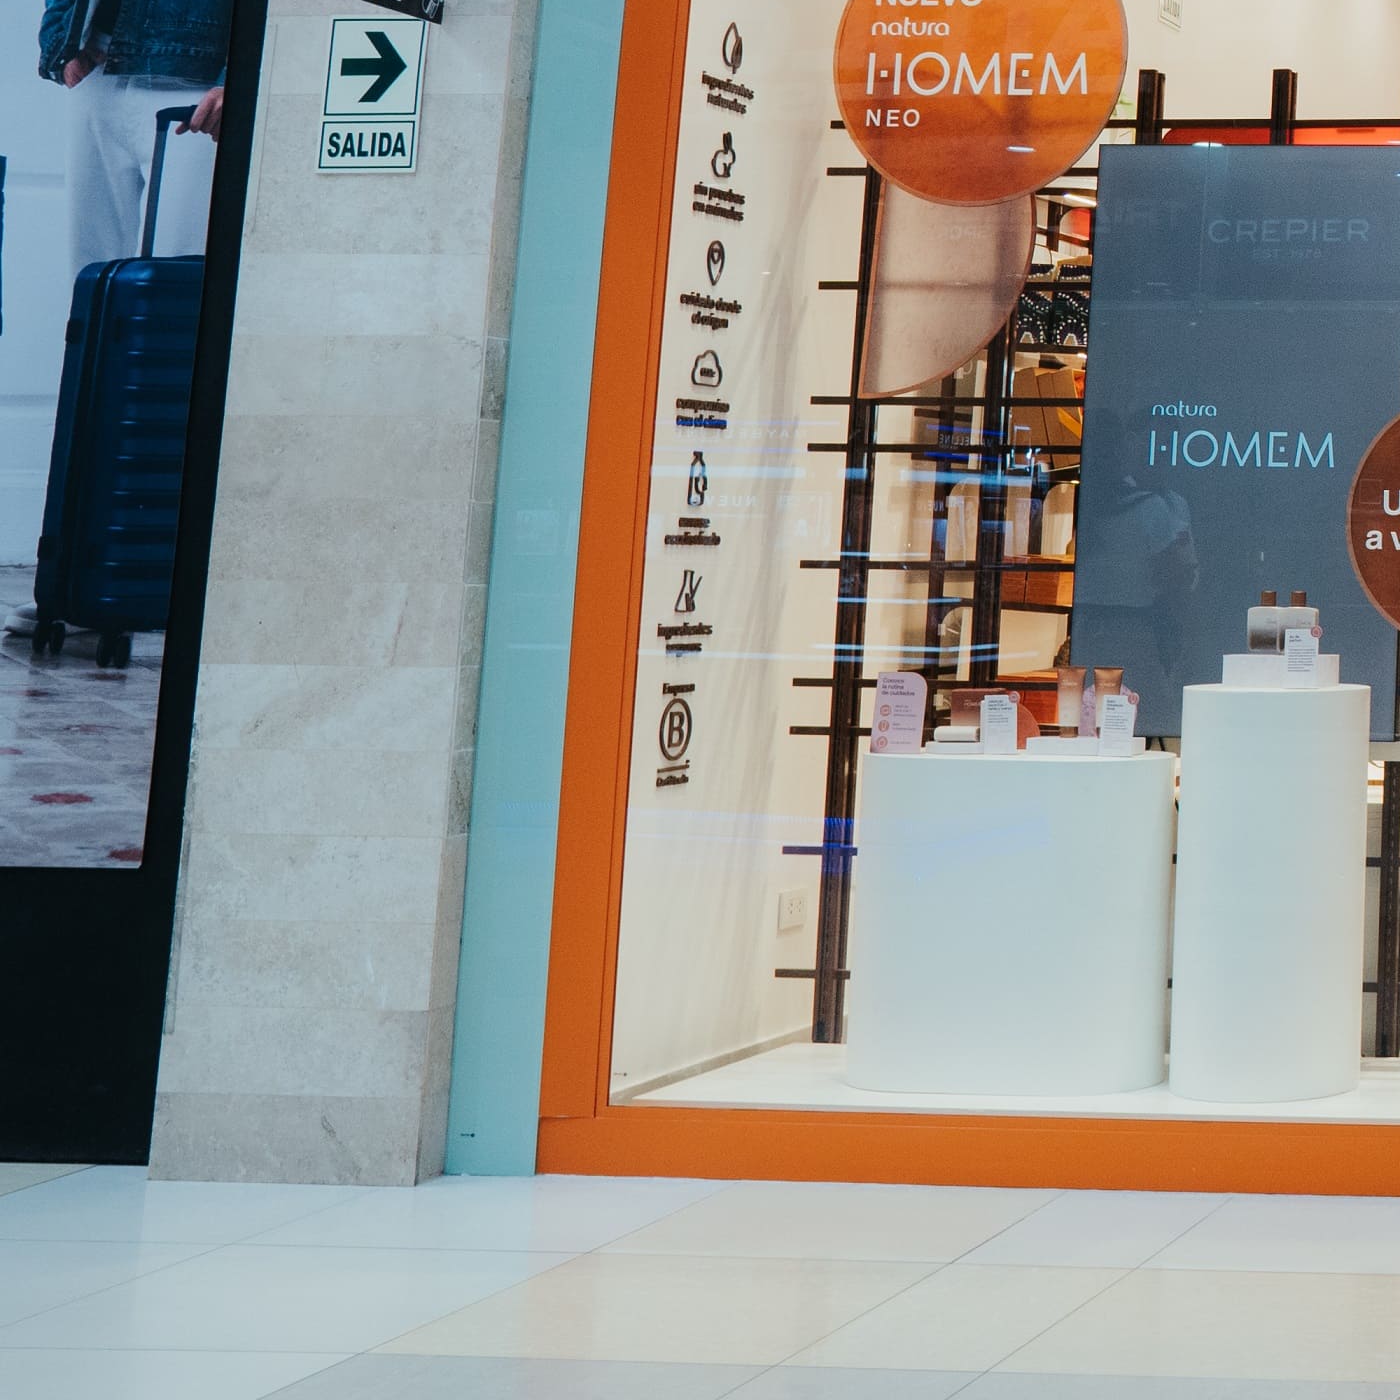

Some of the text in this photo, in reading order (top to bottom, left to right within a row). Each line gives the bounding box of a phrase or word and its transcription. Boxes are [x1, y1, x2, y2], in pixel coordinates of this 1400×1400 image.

[871, 17, 950, 37] natura
[866, 51, 1088, 96] HOMEM
[865, 109, 921, 127] NEO
[328, 132, 407, 158] SALIDA
[1152, 400, 1217, 418] natura
[1149, 430, 1335, 468] HOMEM
[1365, 528, 1383, 550] a
